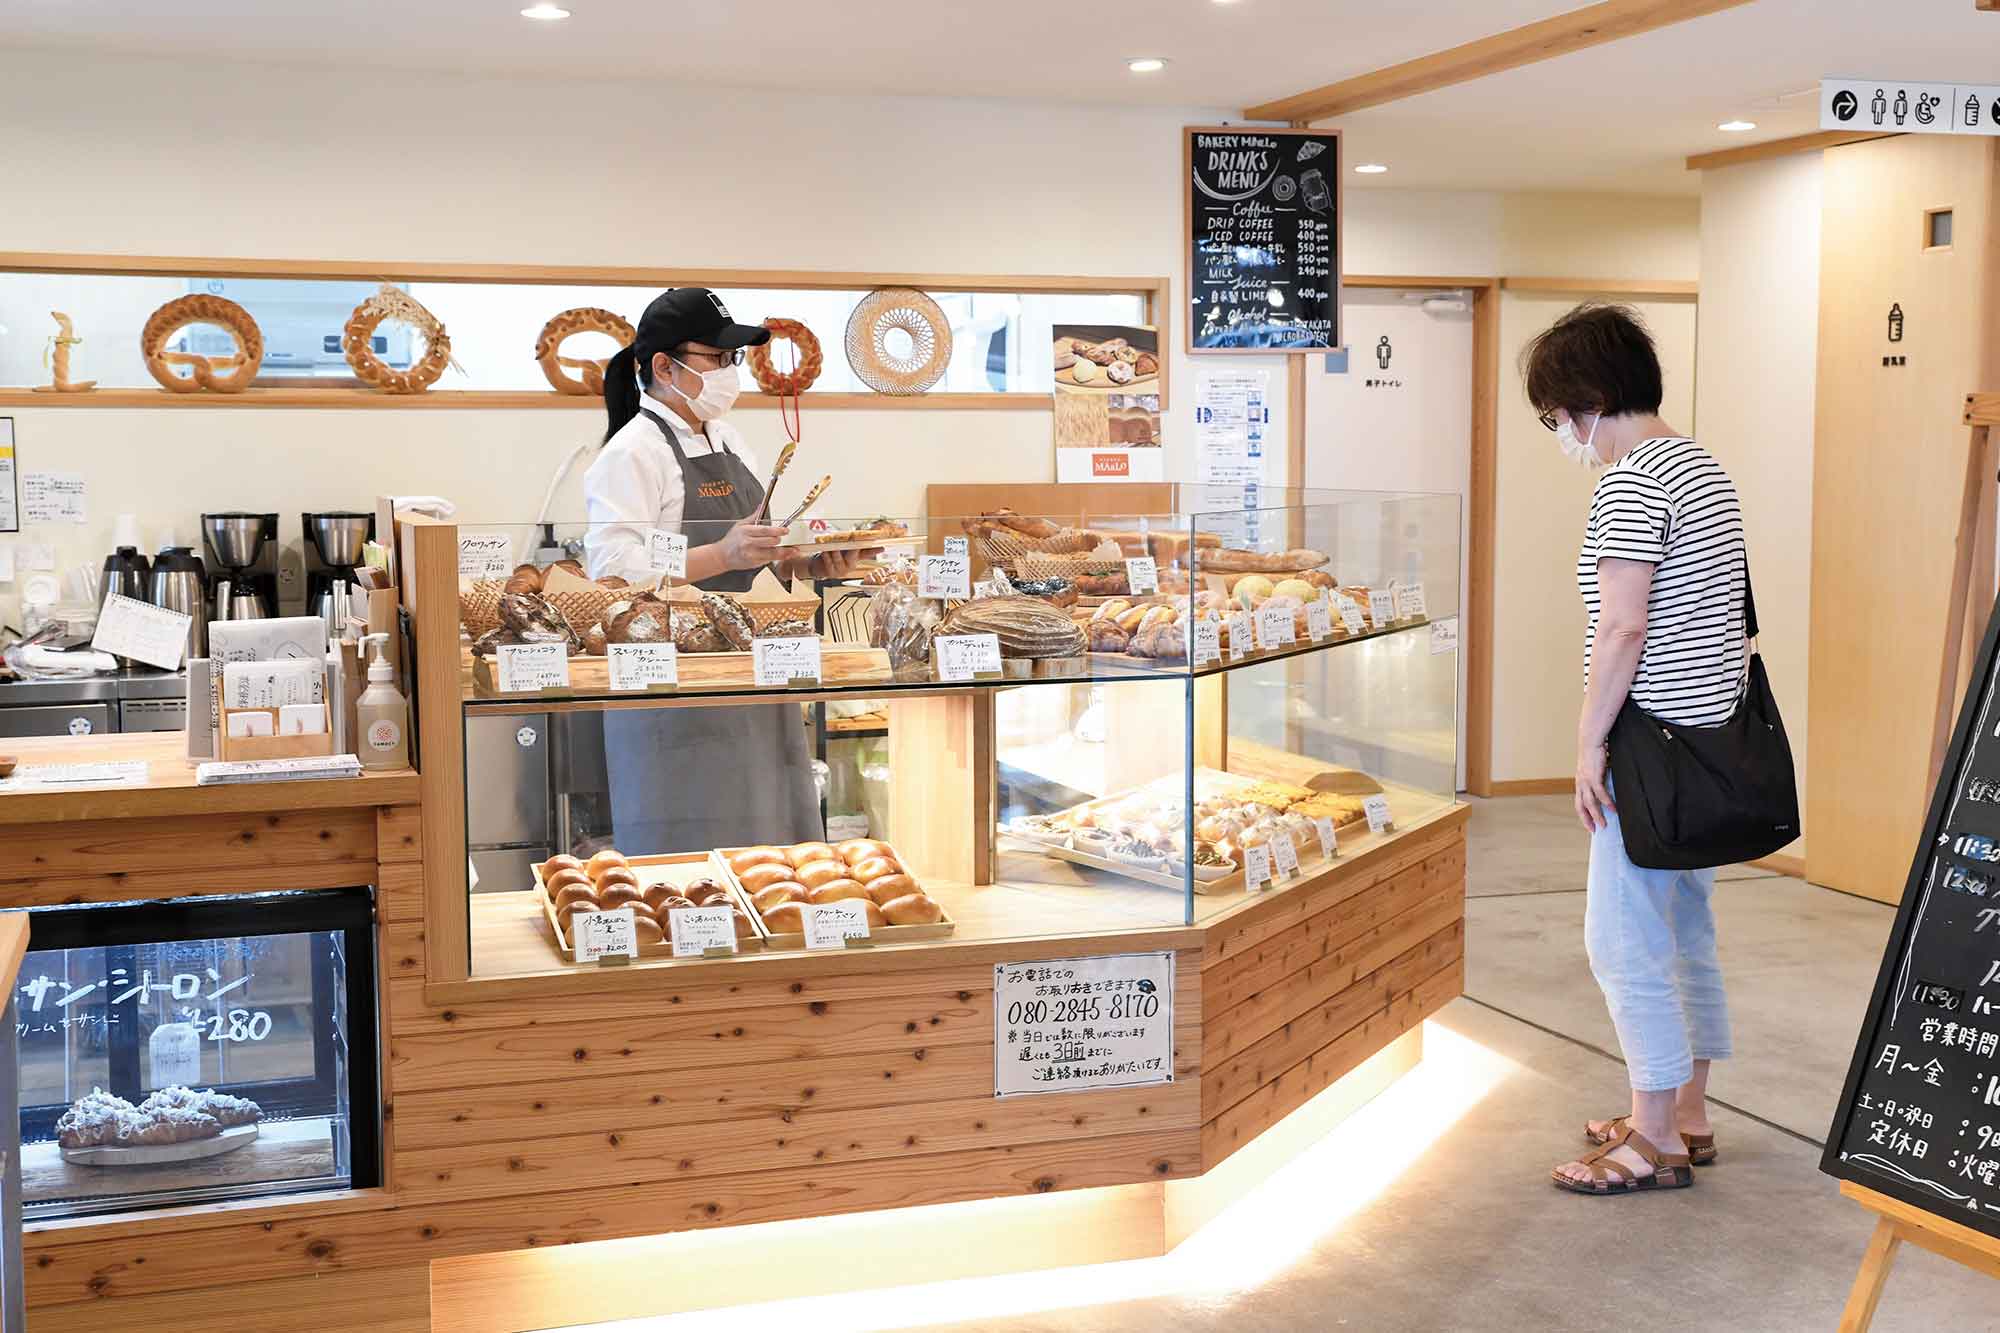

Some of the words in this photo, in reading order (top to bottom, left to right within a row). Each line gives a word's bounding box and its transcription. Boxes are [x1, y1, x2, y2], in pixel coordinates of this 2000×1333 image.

[1198, 134, 1239, 148] BAKERY
[1208, 151, 1268, 171] DRINKS
[1218, 171, 1260, 189] MENU
[1233, 201, 1273, 218] Coffee
[1207, 218, 1234, 230] DRIP
[1239, 218, 1273, 230] COFFEE
[1209, 231, 1233, 241] ICED
[1240, 231, 1273, 241] COFFEE
[1297, 231, 1315, 241] 400
[1297, 243, 1315, 253] 550
[1297, 255, 1315, 265] 450
[1209, 268, 1233, 279] MILK
[1297, 267, 1315, 276] 240
[1231, 275, 1268, 290] Juice
[1297, 288, 1315, 298] 400
[461, 539, 507, 551] クロワッサン
[763, 642, 801, 652] フルーツ
[1007, 968, 1074, 984] お電話での
[15, 967, 255, 1012] サン・シトロン
[1035, 980, 1136, 997] お取りおきできます
[1007, 993, 1159, 1025] 080-2845-8170
[1919, 1017, 1999, 1059] 営業時間
[1866, 1119, 1929, 1159] 定休日
